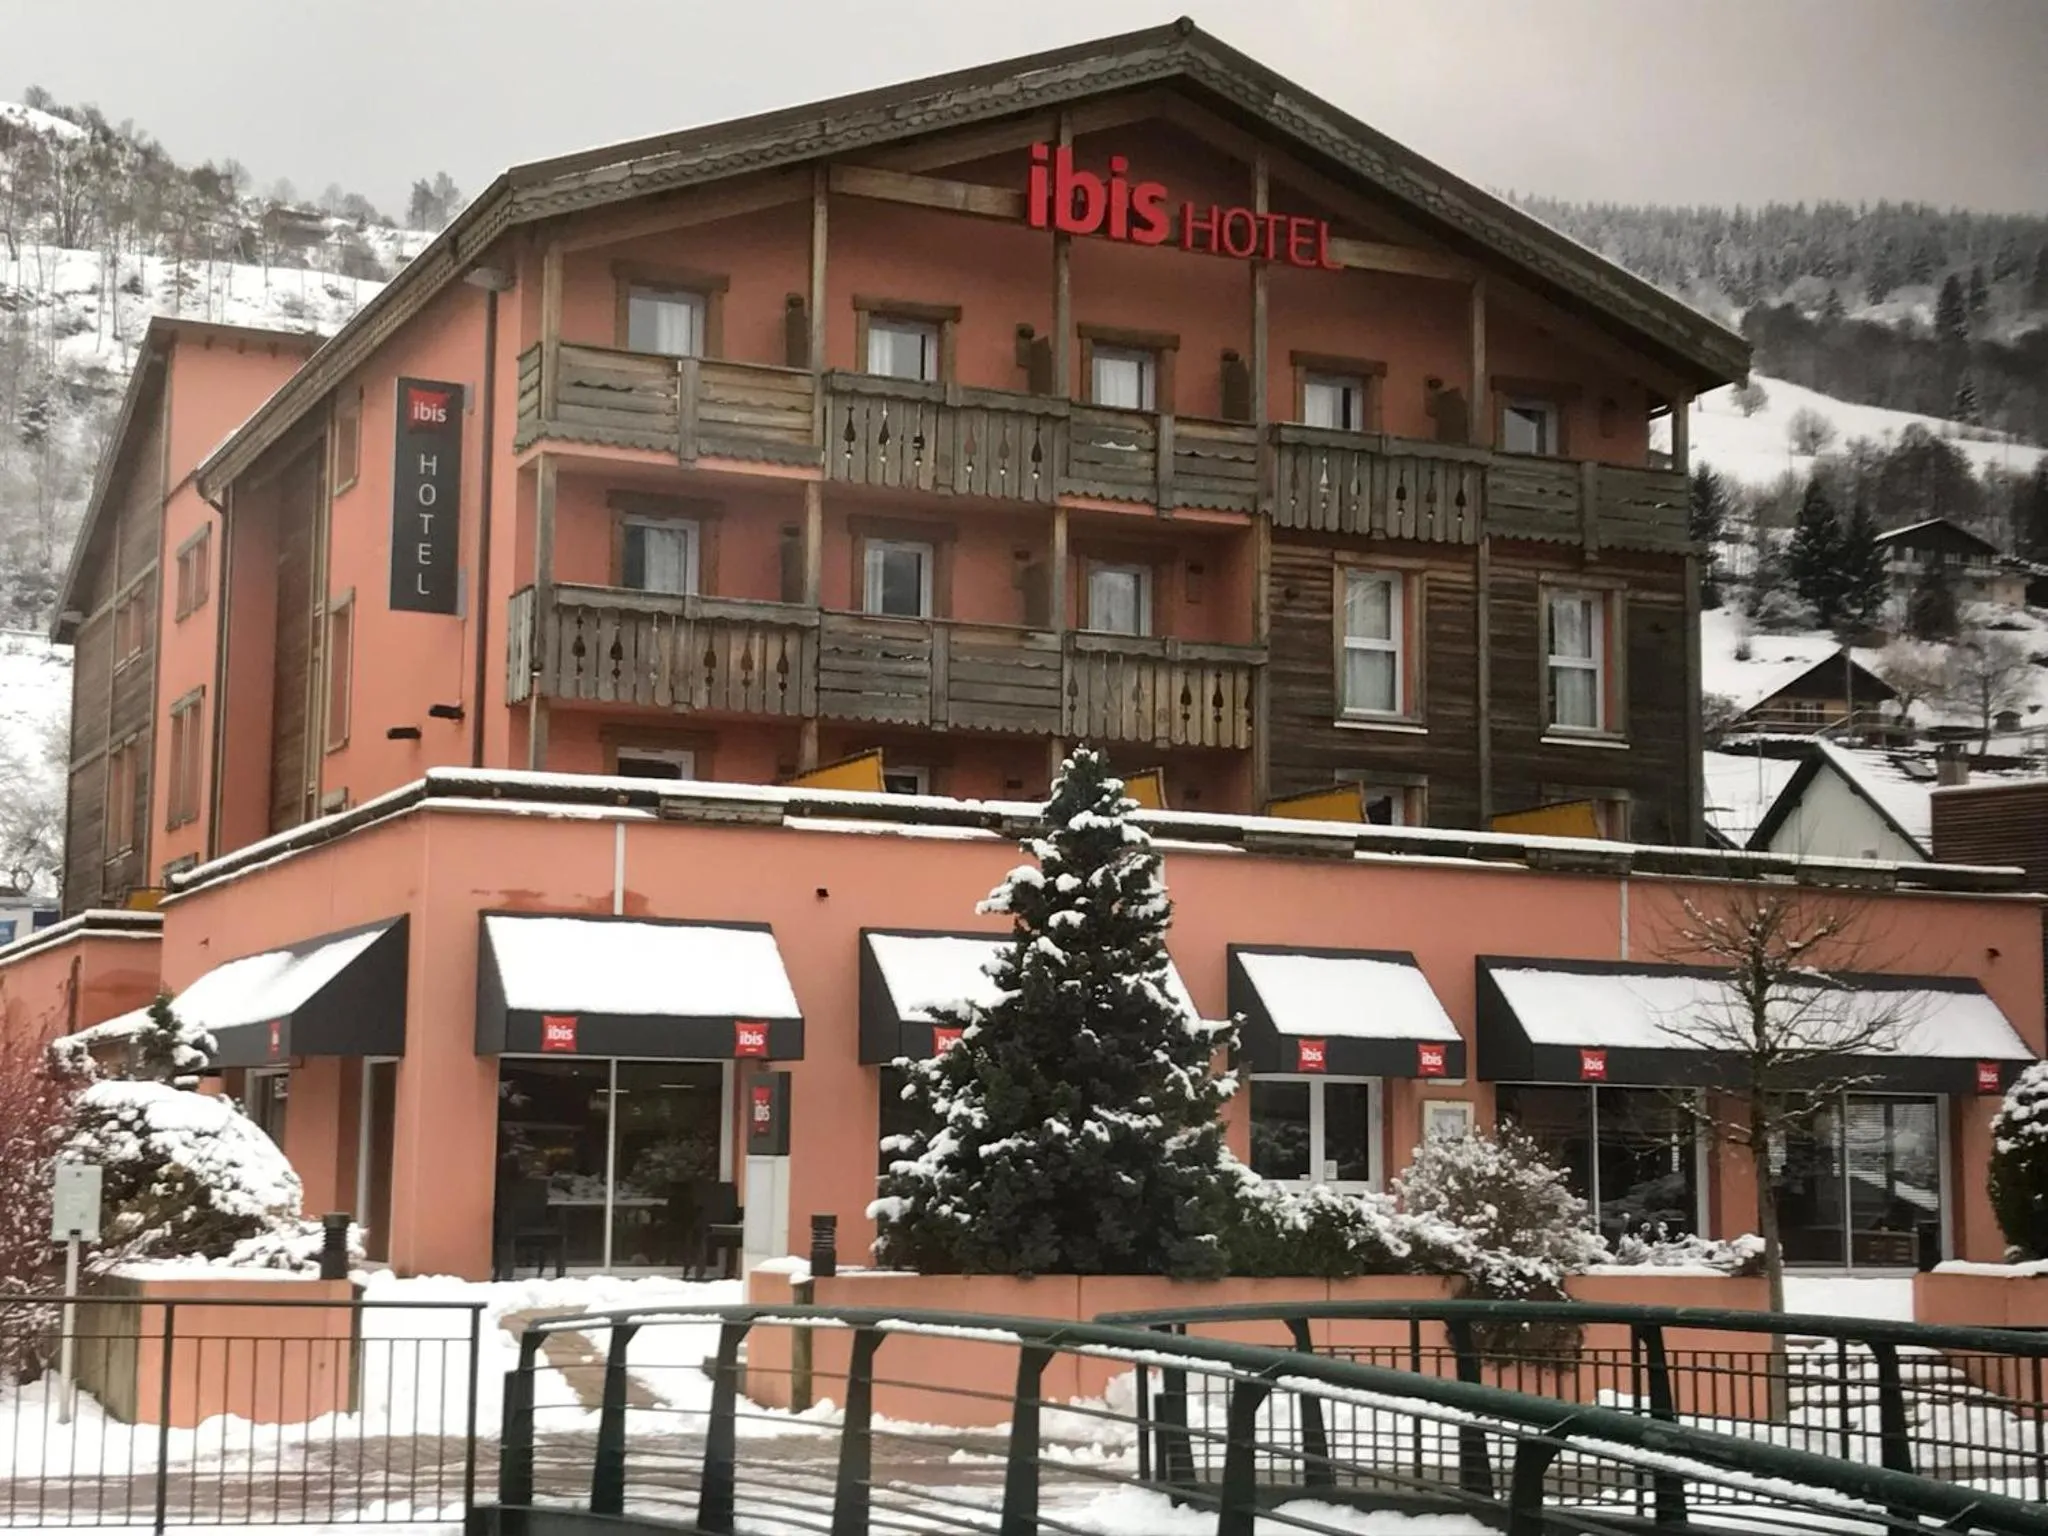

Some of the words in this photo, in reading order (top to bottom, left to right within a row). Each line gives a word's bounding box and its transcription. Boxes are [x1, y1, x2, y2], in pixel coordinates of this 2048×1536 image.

[1028, 141, 1170, 245] ibis
[1180, 201, 1345, 269] HOTEL
[413, 402, 447, 423] ibis
[416, 454, 437, 595] HOTEL
[547, 1024, 573, 1040] ibis
[739, 1031, 764, 1046] ibis
[1302, 1047, 1323, 1062] ibis
[1421, 1051, 1443, 1066] ibis
[1583, 1057, 1604, 1071] ibis
